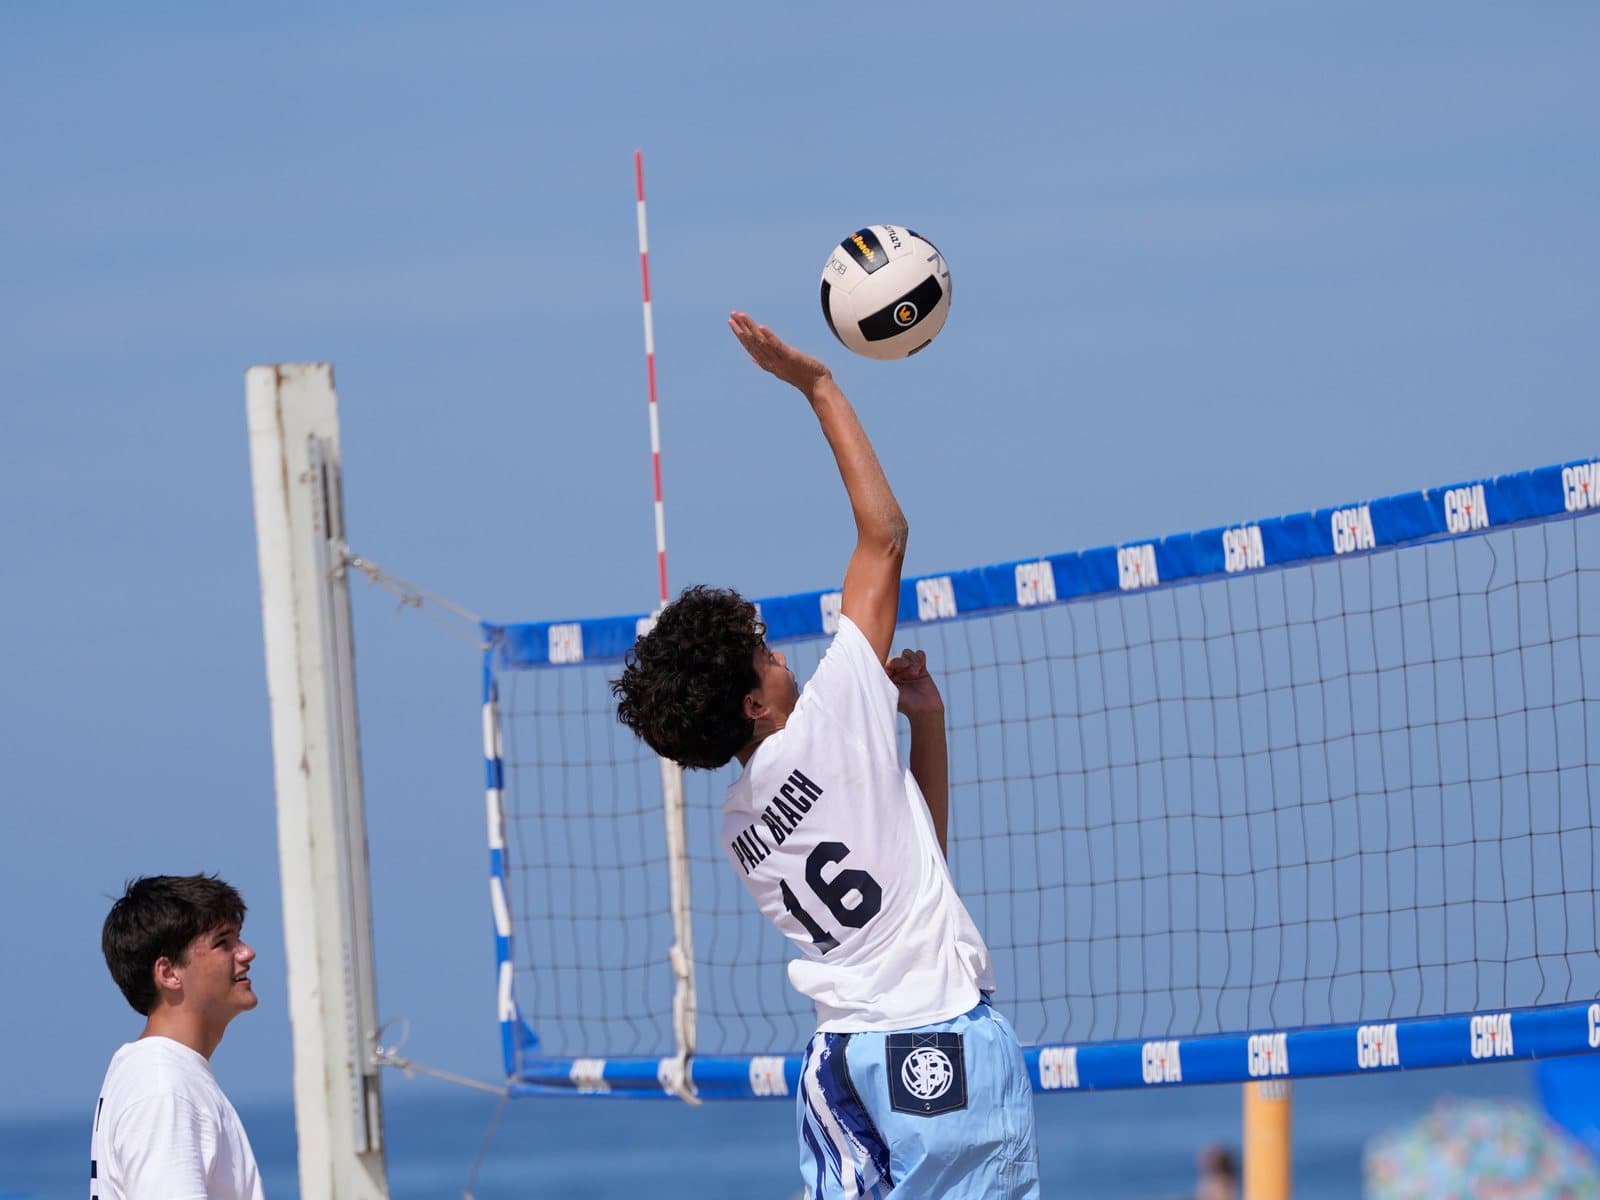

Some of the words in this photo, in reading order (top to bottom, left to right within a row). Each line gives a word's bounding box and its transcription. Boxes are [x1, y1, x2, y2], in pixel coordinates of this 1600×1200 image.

[1331, 506, 1376, 554] CBVA
[1444, 484, 1489, 534] CBVA
[760, 768, 824, 847] BEACH
[779, 841, 883, 957] 16
[1356, 1023, 1399, 1068] CBVA
[1470, 1013, 1513, 1058] CBVA
